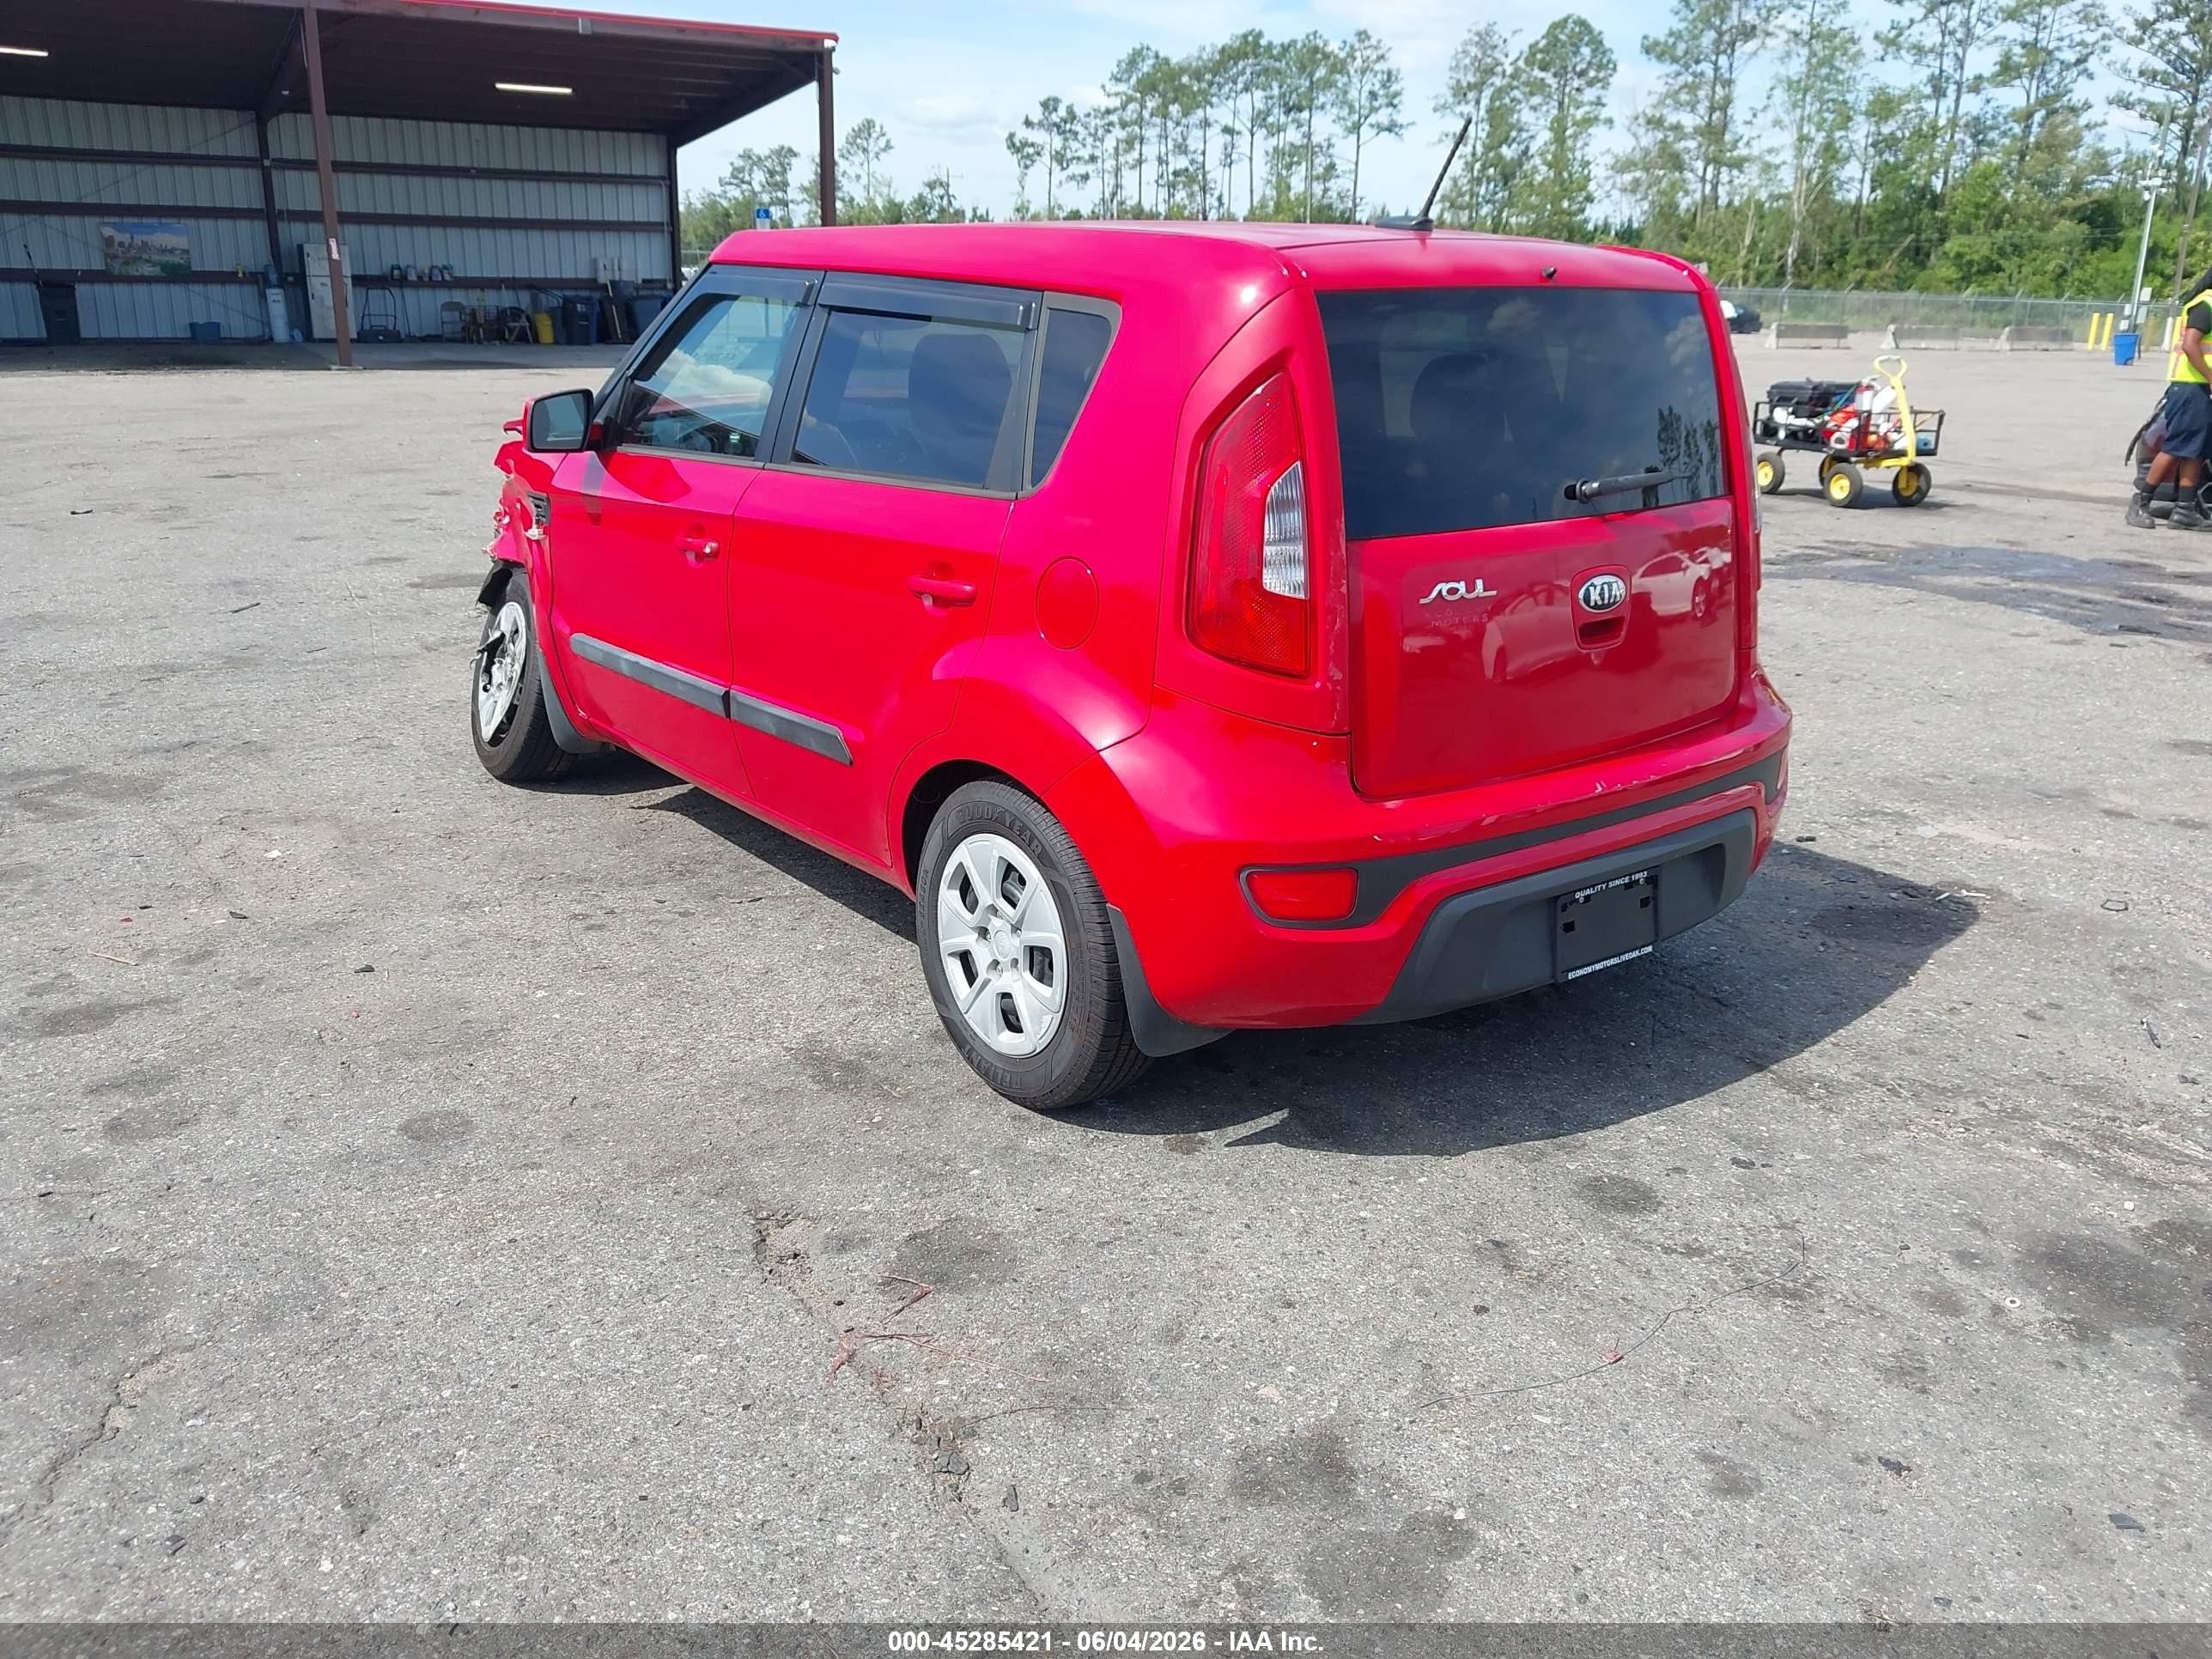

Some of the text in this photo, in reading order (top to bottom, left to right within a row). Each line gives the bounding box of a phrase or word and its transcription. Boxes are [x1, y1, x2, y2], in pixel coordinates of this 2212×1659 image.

[1419, 578, 1498, 604] SOUL
[1574, 871, 1648, 899] QUALITY SINCE 1993
[1567, 945, 1653, 980] ECONOMYMOTORSLIVEOAK.COM
